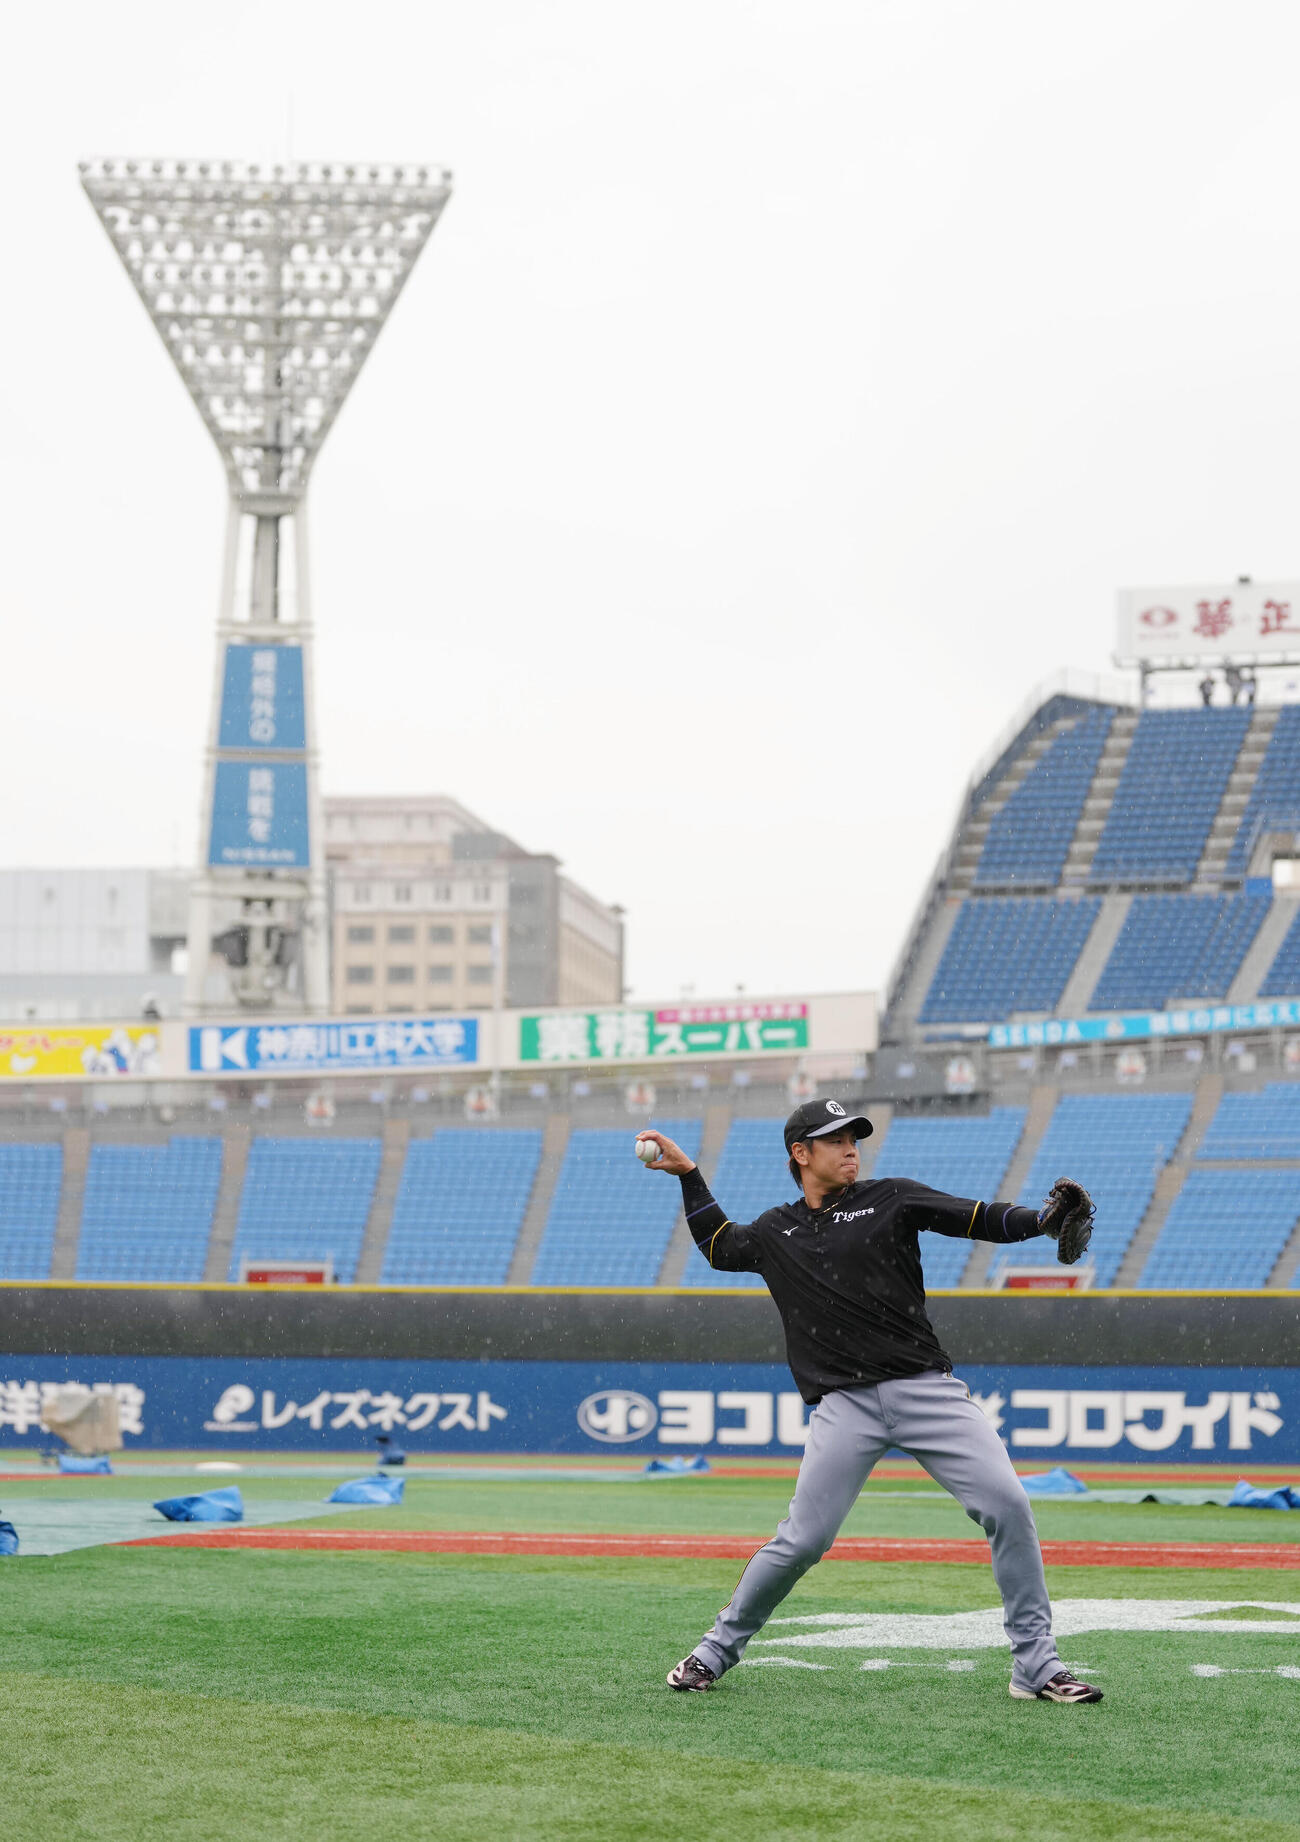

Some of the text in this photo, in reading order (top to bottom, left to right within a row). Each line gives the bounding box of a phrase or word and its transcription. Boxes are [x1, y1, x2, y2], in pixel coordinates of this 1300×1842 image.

[257, 1022, 464, 1060] 神奈川工科大学
[537, 1011, 797, 1060] 業務スーパー
[832, 1207, 875, 1223] Tigers
[261, 1390, 508, 1431] レイズネクスト
[1012, 1390, 1284, 1450] コロワイド
